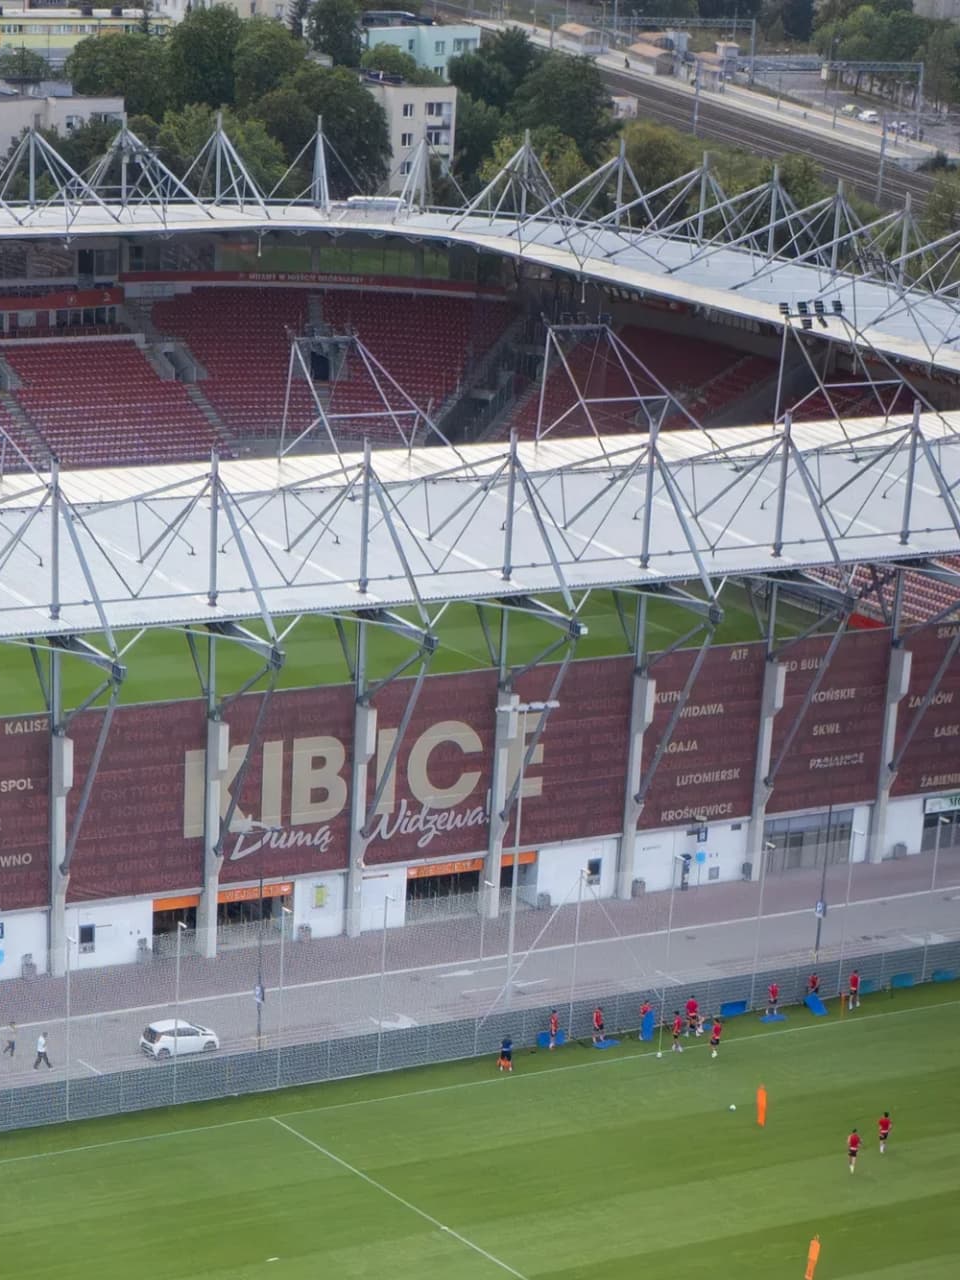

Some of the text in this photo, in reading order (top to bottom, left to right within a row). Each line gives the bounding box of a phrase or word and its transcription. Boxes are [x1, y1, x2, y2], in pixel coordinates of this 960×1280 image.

[5, 719, 49, 735] KALISZ
[183, 711, 544, 839] KIBICE
[676, 768, 741, 787] LUTOMIERSK
[661, 802, 733, 822] KROŚNIEWICE
